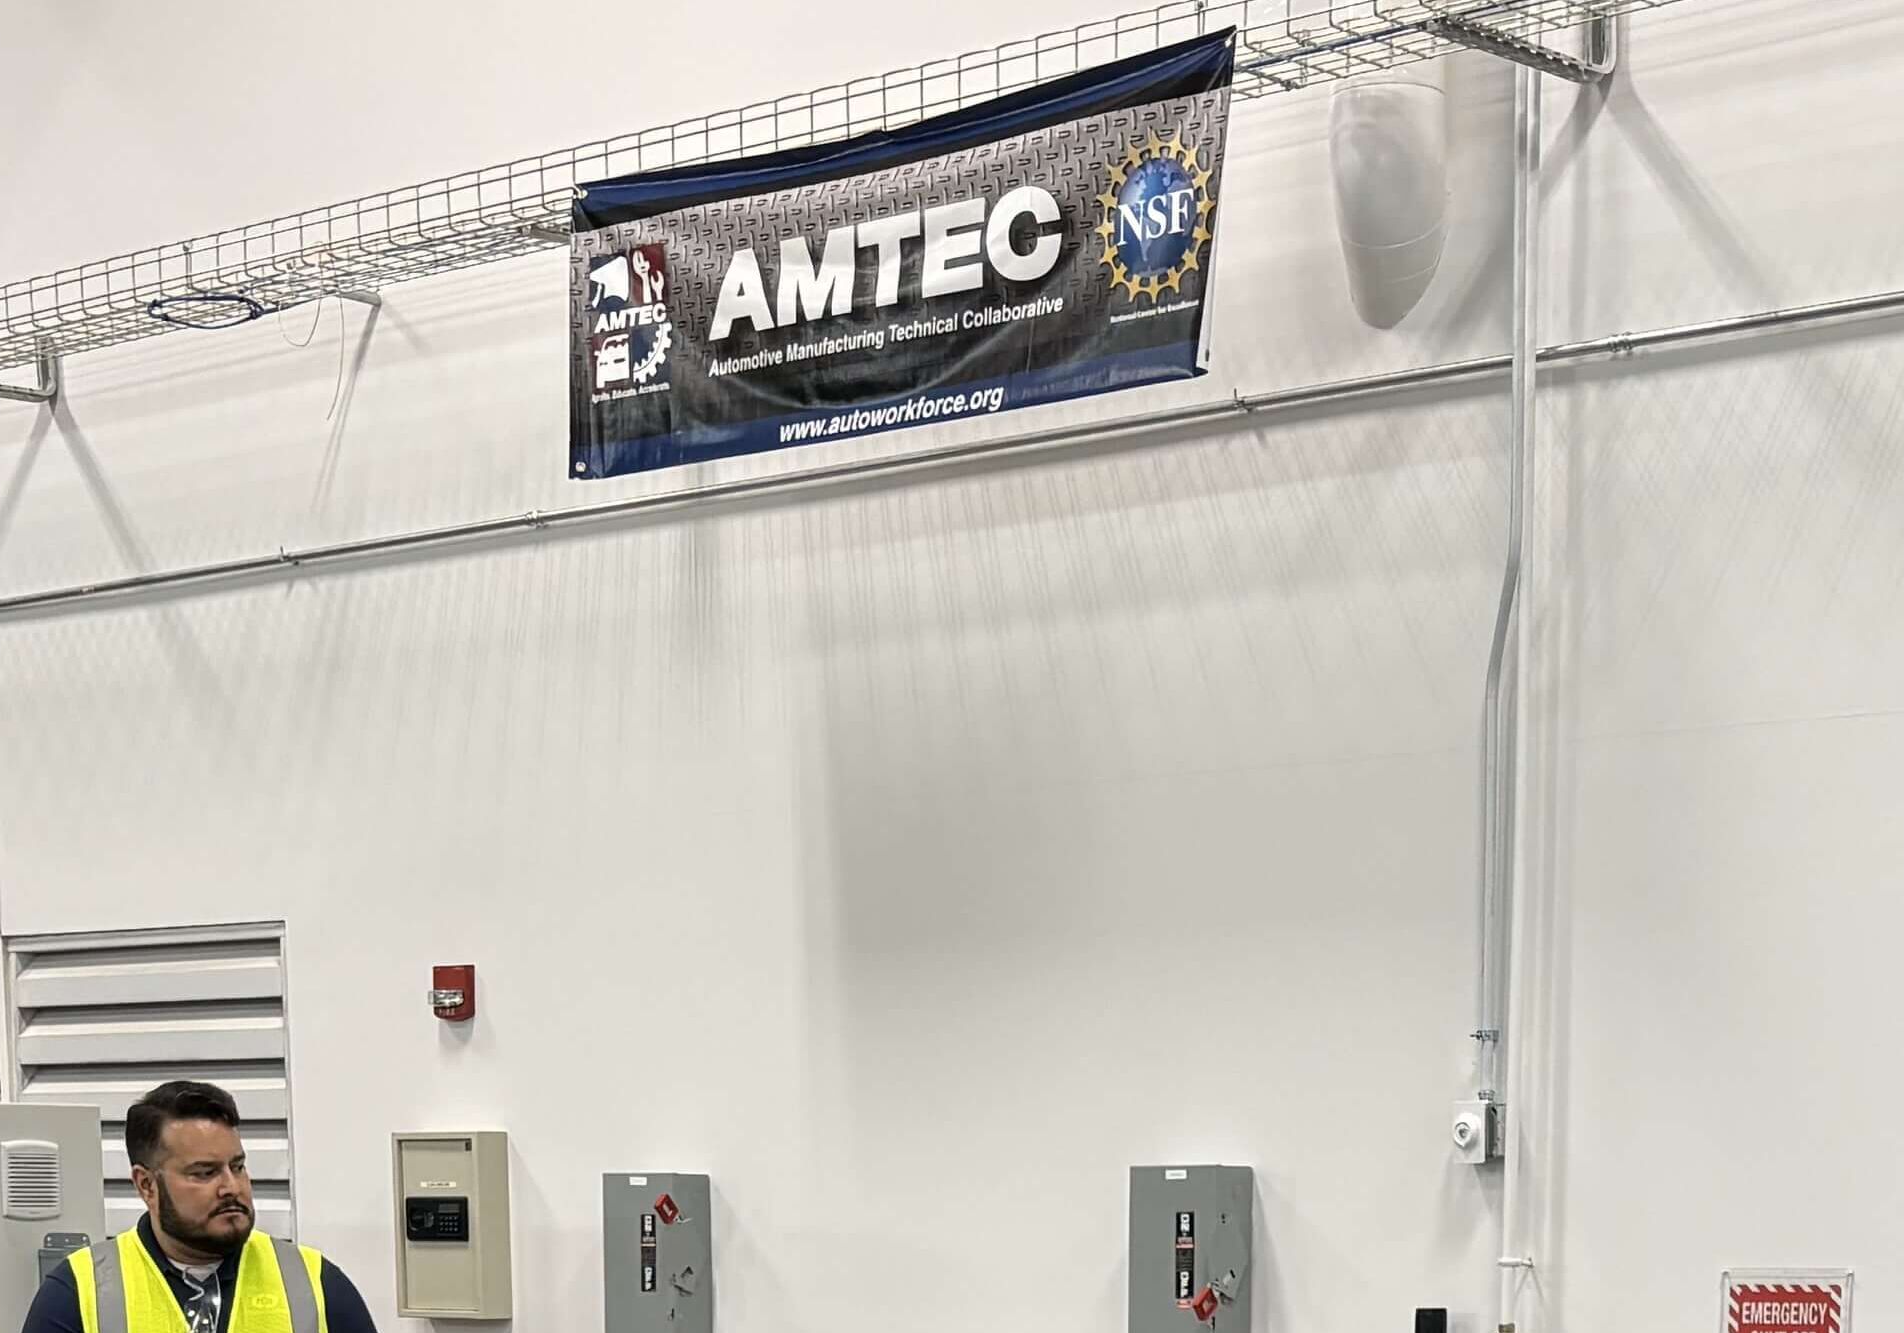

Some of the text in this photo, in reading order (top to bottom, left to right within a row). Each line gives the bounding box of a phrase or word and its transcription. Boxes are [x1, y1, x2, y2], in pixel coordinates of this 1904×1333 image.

[1116, 188, 1194, 246] NSF
[708, 185, 1063, 341] AMTEC
[594, 302, 666, 333] AMTEC
[708, 296, 1064, 378] Automotive Manufacturing Technical Collaborative
[780, 385, 1005, 443] www.autoworkforce.org
[1742, 1302, 1828, 1325] EMERGENCY
